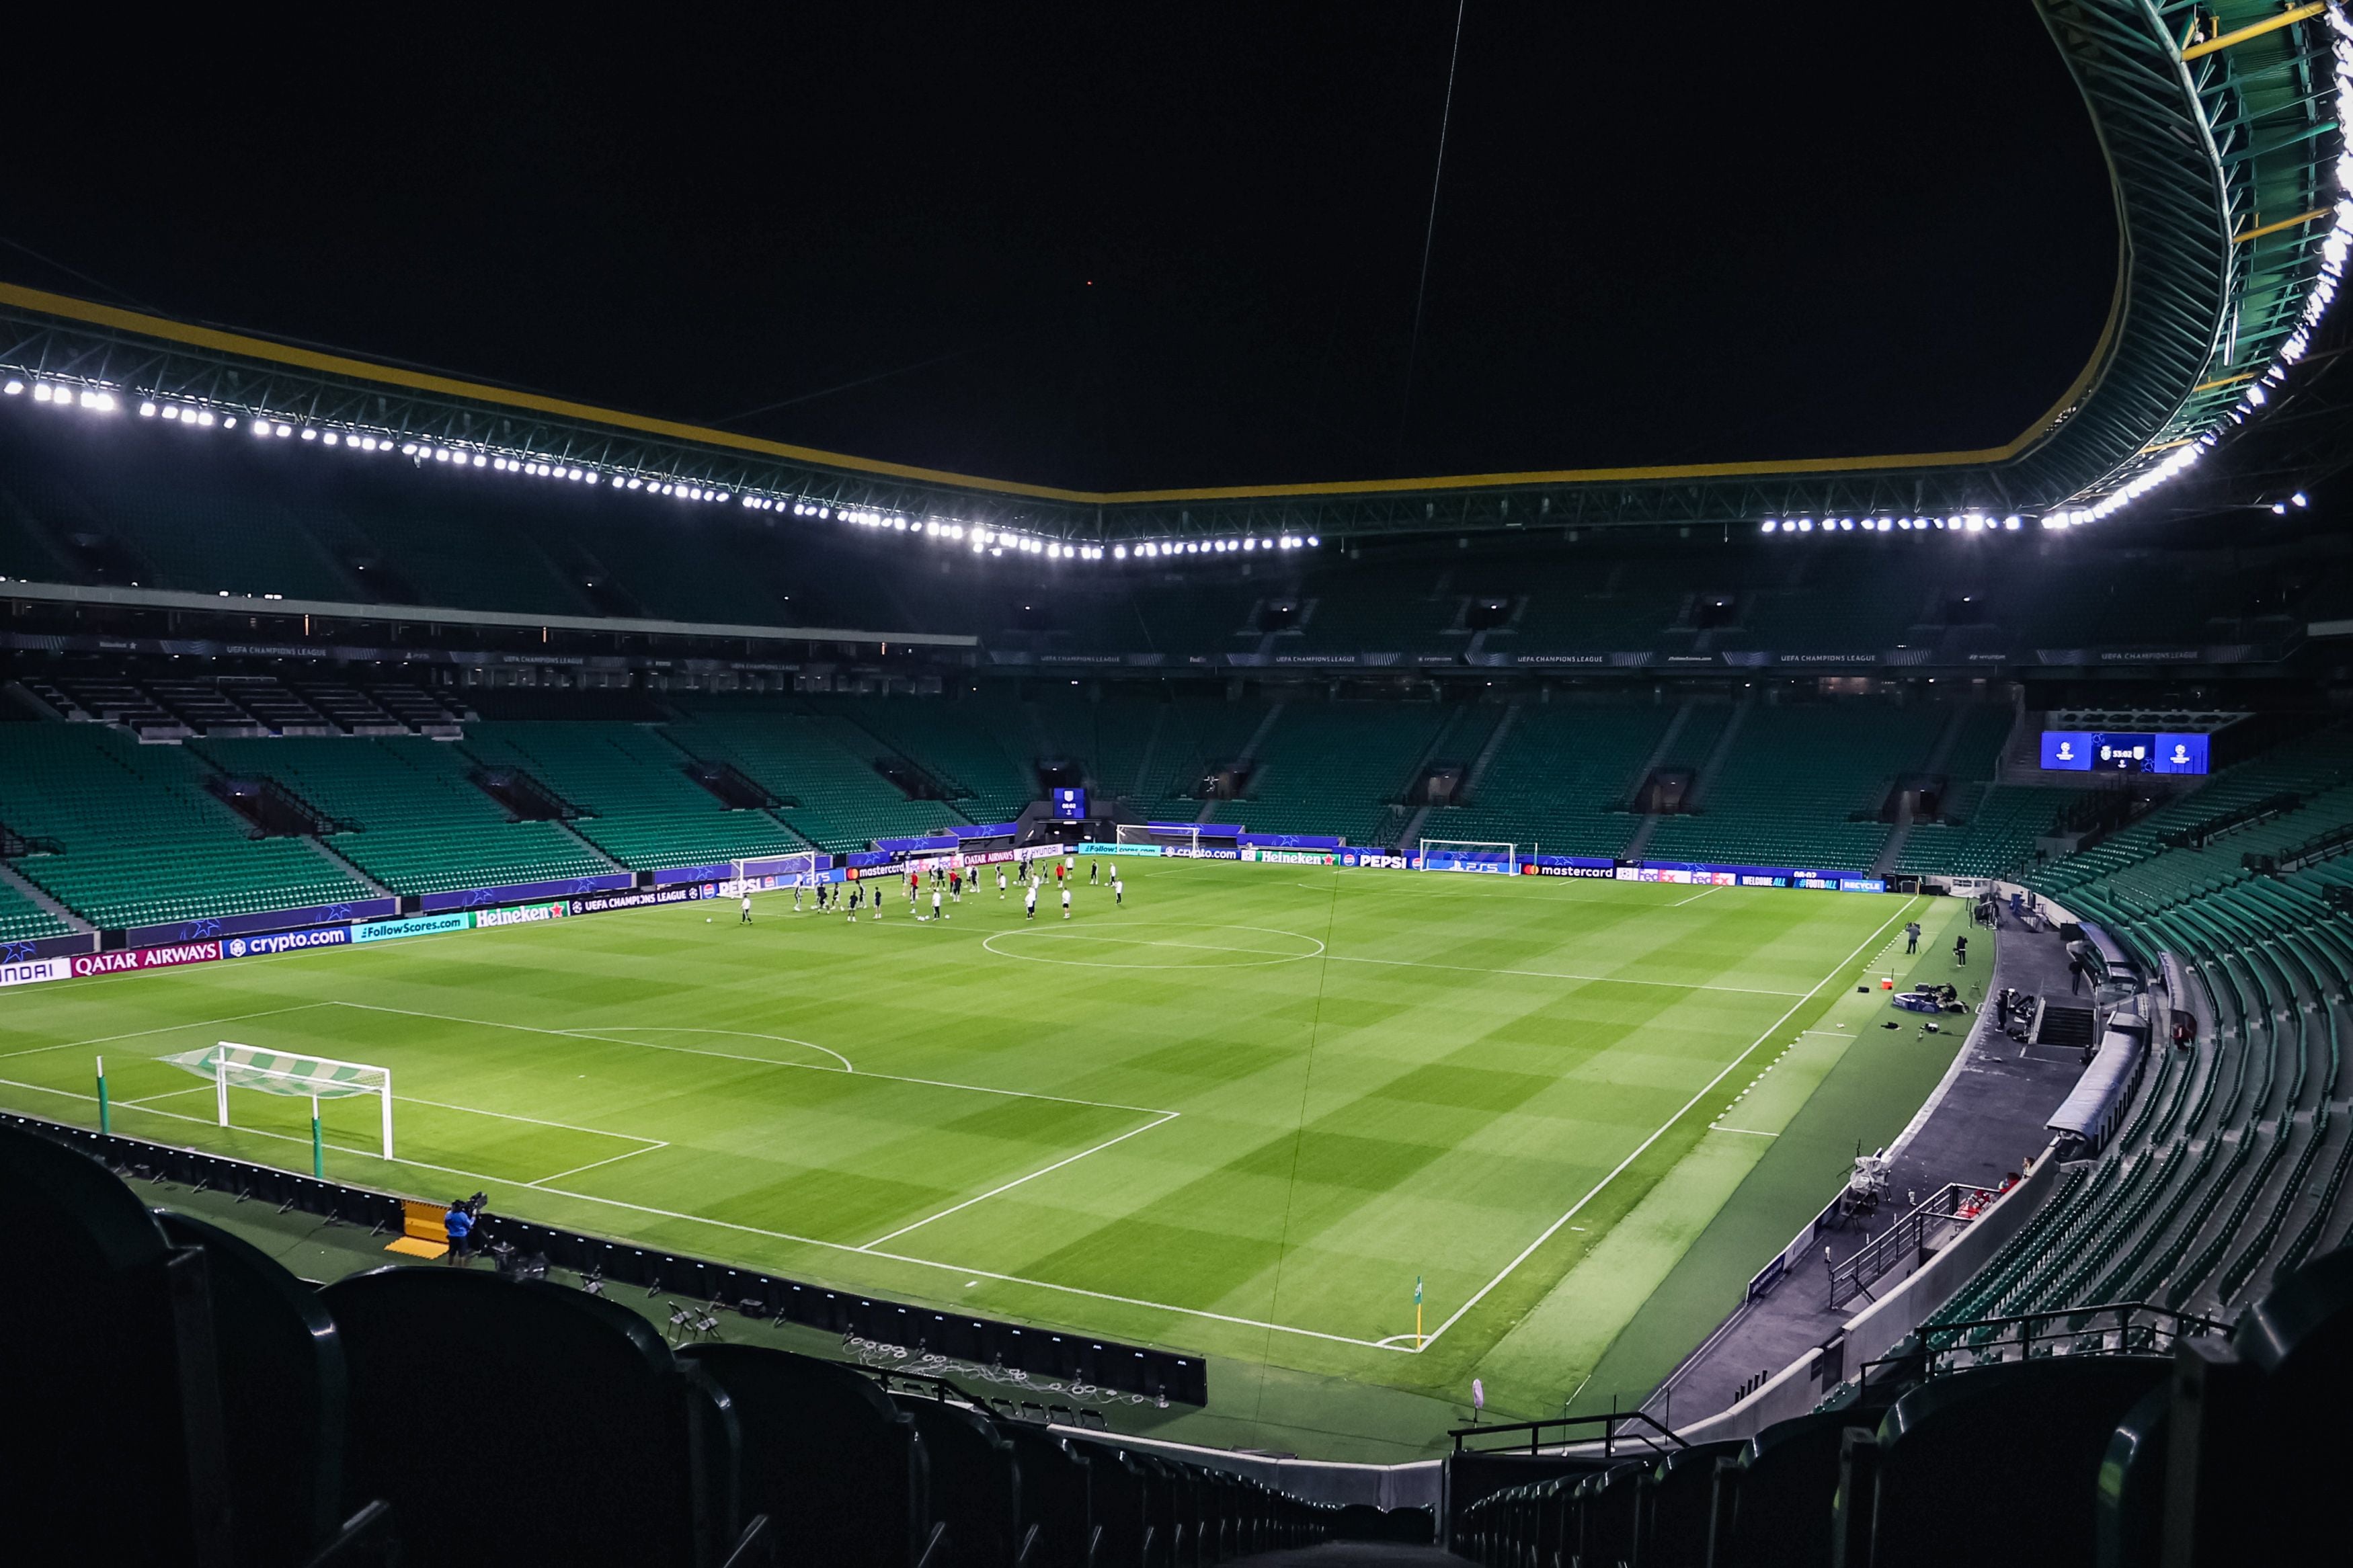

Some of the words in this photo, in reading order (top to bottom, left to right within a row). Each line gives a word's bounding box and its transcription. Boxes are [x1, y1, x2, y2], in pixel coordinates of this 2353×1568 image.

[227, 645, 247, 653] UEFA
[249, 647, 296, 655] CHAMPIONS
[297, 648, 326, 657] LEAGUE
[964, 856, 986, 865] QATAR
[988, 851, 1014, 862] AIRWAYS
[1261, 851, 1322, 865] Heineken
[1359, 854, 1407, 869] PEPSI
[859, 861, 904, 877] mastercard
[1466, 862, 1499, 872] PS5
[1542, 865, 1613, 878] mastercard
[1638, 868, 1675, 882] FedEx
[1691, 871, 1729, 885] FedEx
[1743, 876, 1773, 886] WELCOME
[1773, 877, 1786, 886] ALL
[719, 878, 761, 895] PEPSI
[1799, 878, 1837, 889] #FOOTBALL
[1844, 882, 1880, 891] RECYCLE
[585, 899, 605, 911] UEFA
[608, 894, 655, 909] CHAMPIONS
[657, 890, 686, 901] LEAGUE
[475, 905, 551, 928] Heineken
[368, 918, 461, 938] FollowScores.com
[251, 929, 345, 953] crypto.com
[75, 953, 138, 975] QATAR
[145, 943, 216, 966] AIRWAYS
[0, 963, 53, 983] NDAI
